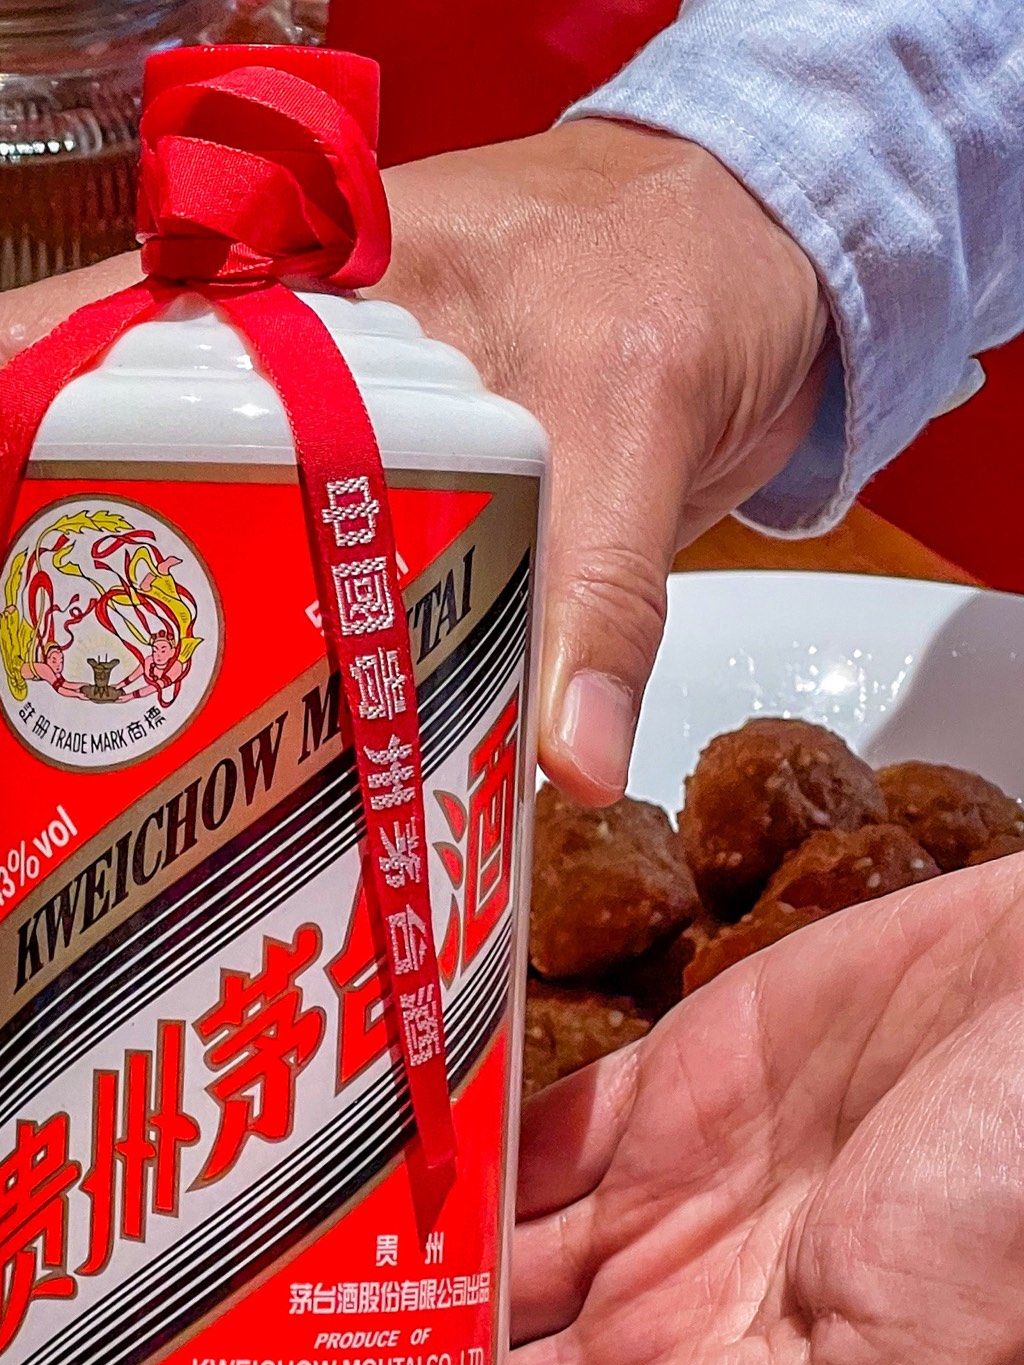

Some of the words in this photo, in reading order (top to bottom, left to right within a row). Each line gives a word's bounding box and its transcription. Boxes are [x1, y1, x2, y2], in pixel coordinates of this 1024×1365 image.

[50, 725, 88, 754] TRADE
[90, 728, 128, 753] MARK
[13, 710, 289, 995] KWEICHOW
[297, 545, 476, 765] MTAI
[32, 804, 79, 859] vol
[288, 1272, 491, 1315] 茅台酒股份有限公司出品
[314, 1330, 401, 1350] PRODUCE
[410, 1327, 432, 1346] OF
